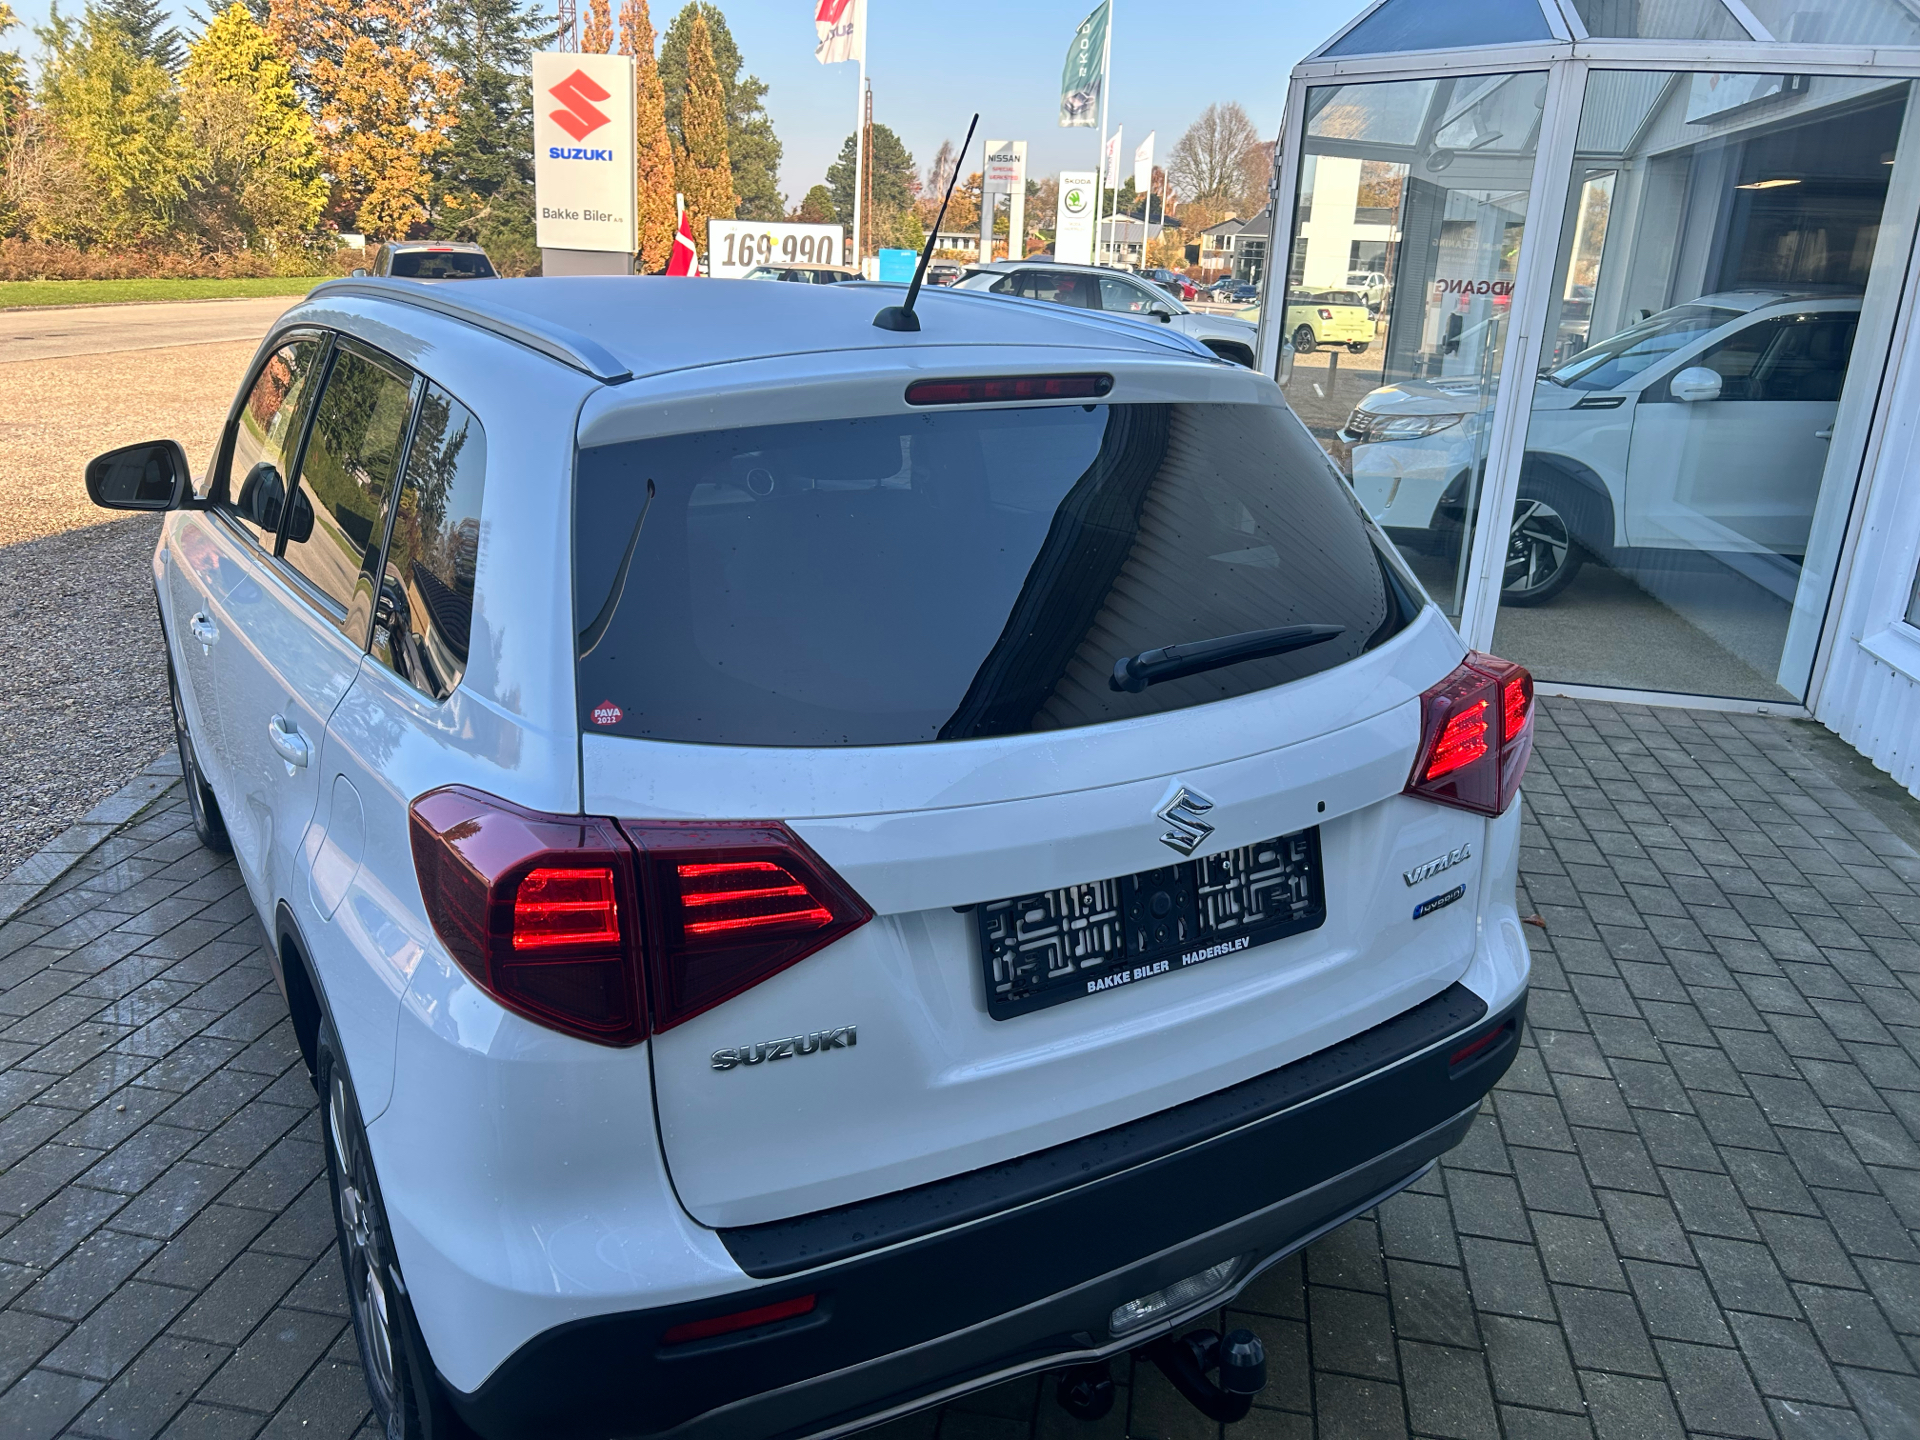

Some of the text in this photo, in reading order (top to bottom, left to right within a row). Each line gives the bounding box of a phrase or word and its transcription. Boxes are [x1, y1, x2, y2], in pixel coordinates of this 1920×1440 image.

[549, 147, 613, 161] SUZUKI
[988, 154, 1021, 163] NISSAN
[542, 207, 580, 220] Bakke
[583, 209, 613, 222] Biler
[594, 708, 621, 718] PAVA
[597, 716, 617, 725] 2022
[1403, 842, 1471, 887] VITARA
[1087, 936, 1251, 993] BAKKE BILER HADERSLEV
[710, 1024, 858, 1071] SUZUKI
